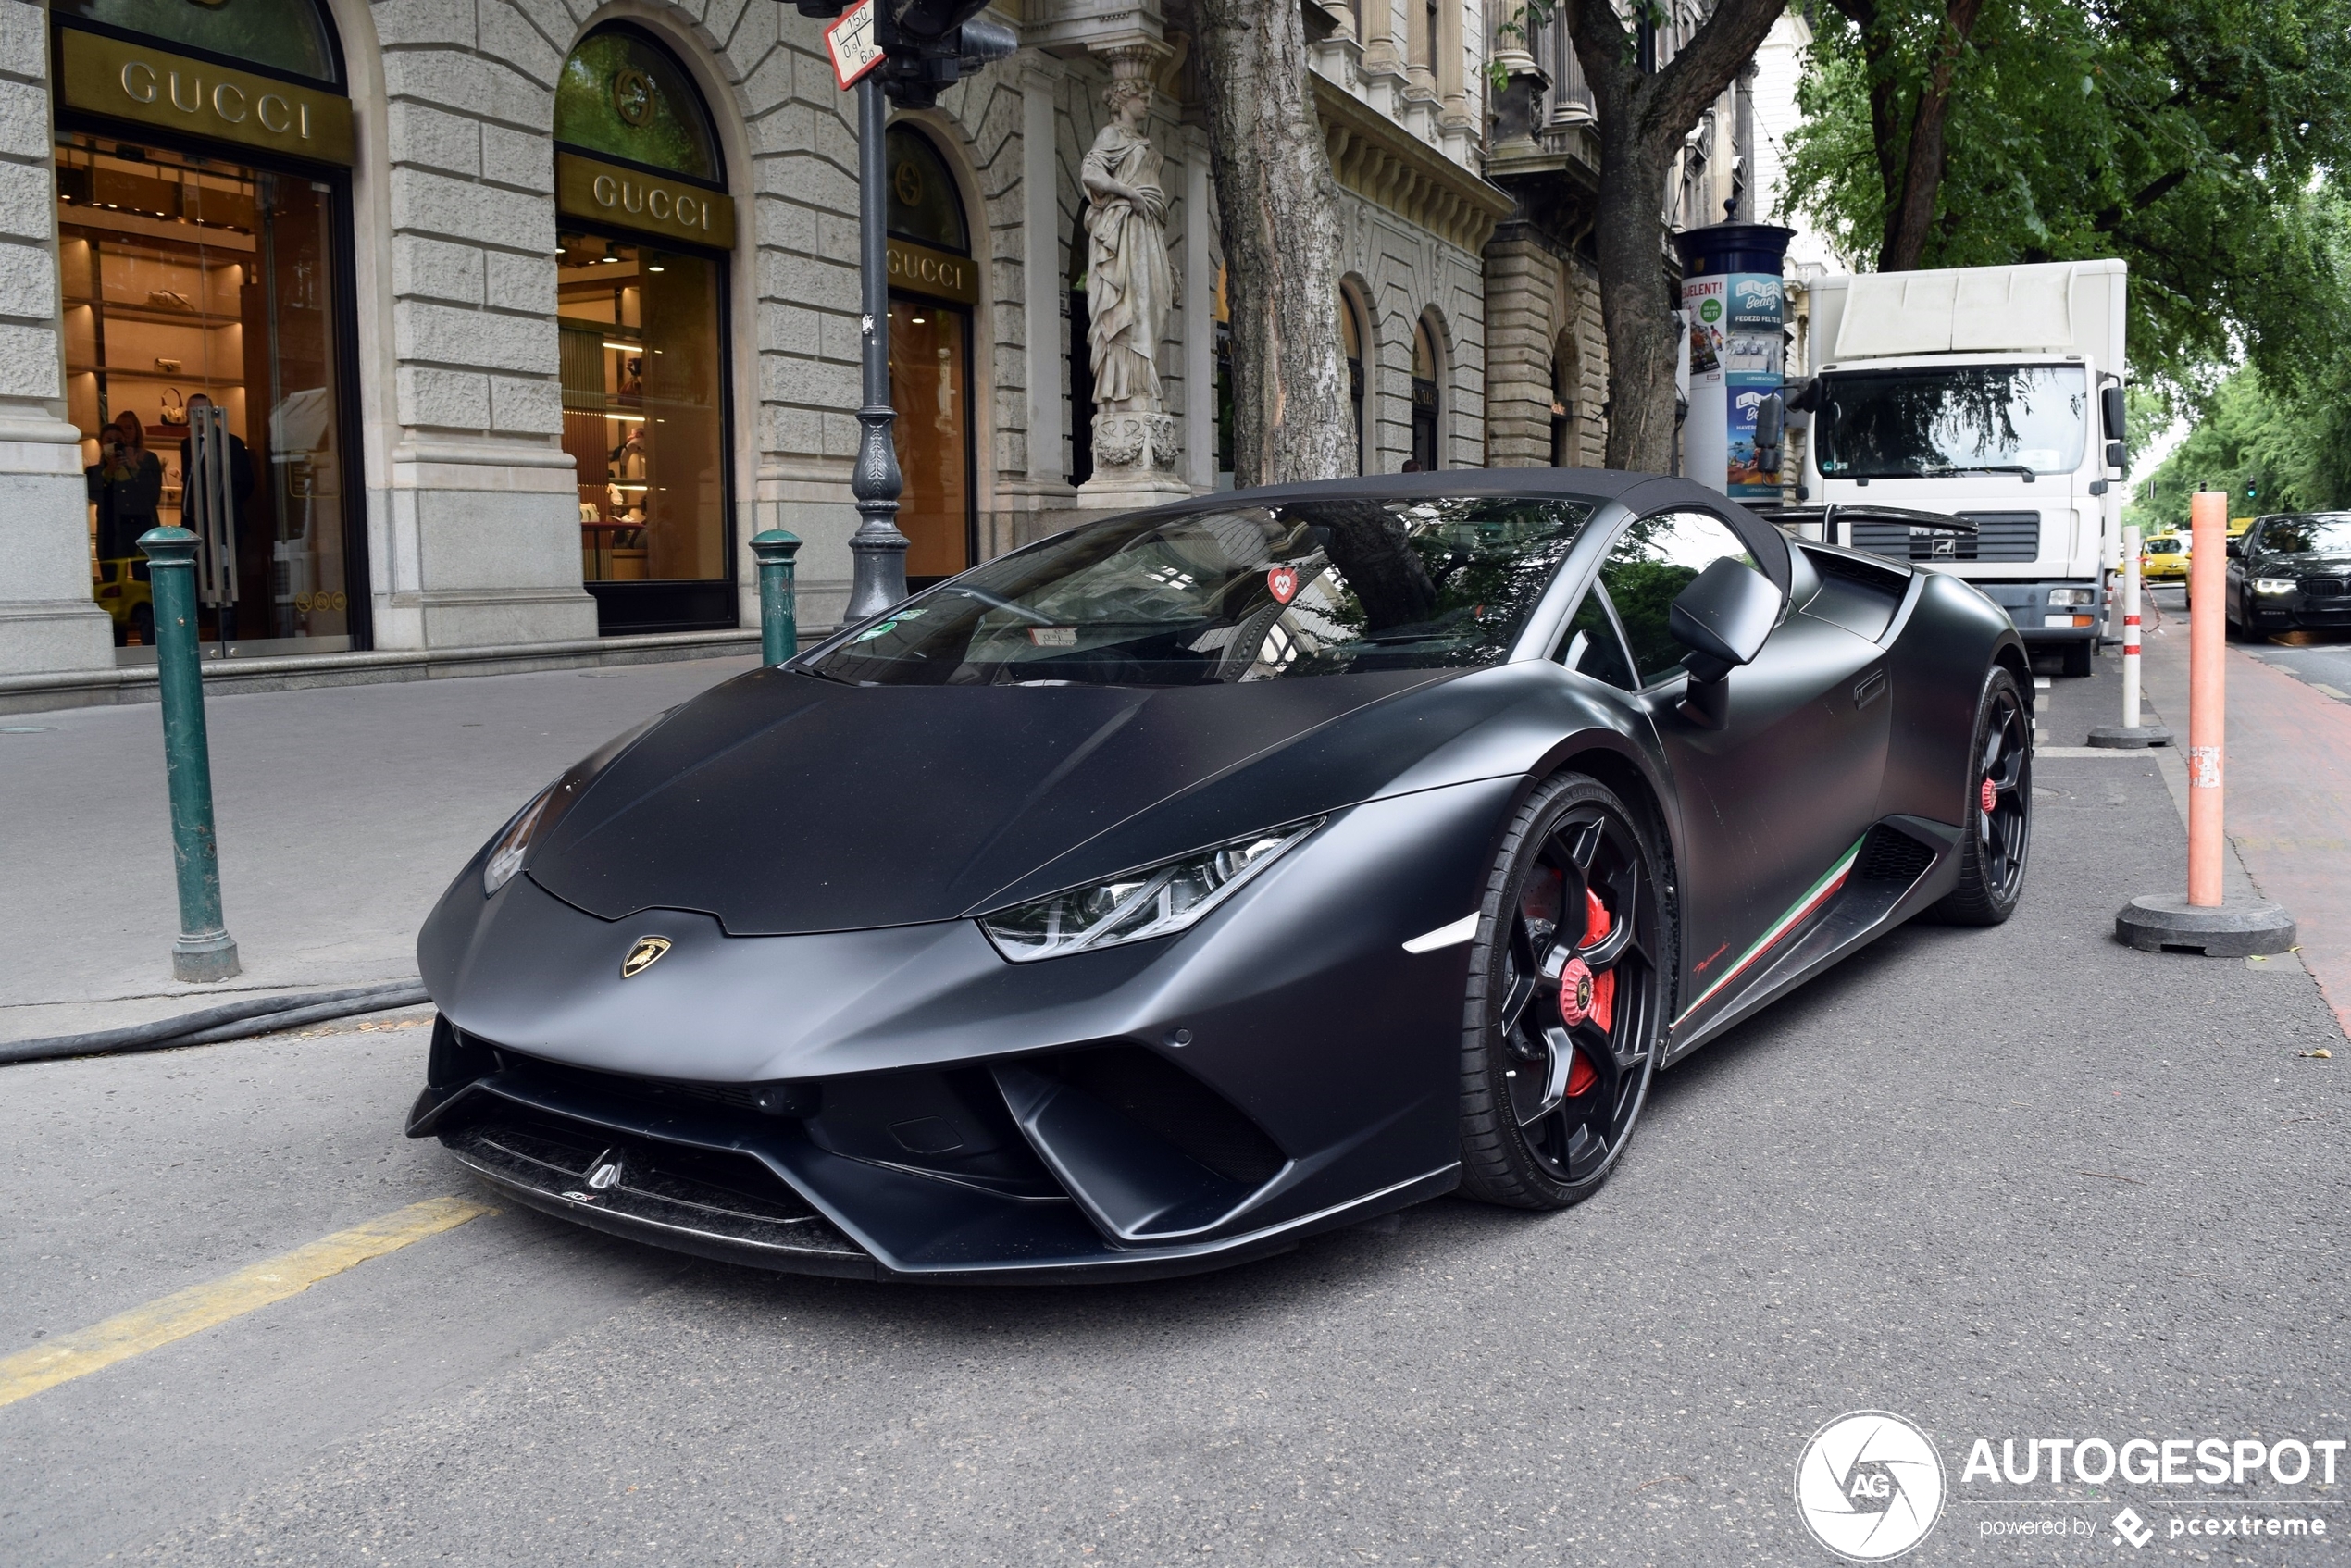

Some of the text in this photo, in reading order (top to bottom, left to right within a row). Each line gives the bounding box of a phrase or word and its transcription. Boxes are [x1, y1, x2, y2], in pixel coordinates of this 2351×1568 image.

[832, 6, 868, 43] T 150
[120, 60, 310, 139] GUCCI
[593, 174, 710, 230] GUCCI
[886, 248, 962, 290] GUCCI
[1746, 294, 1777, 310] Beach
